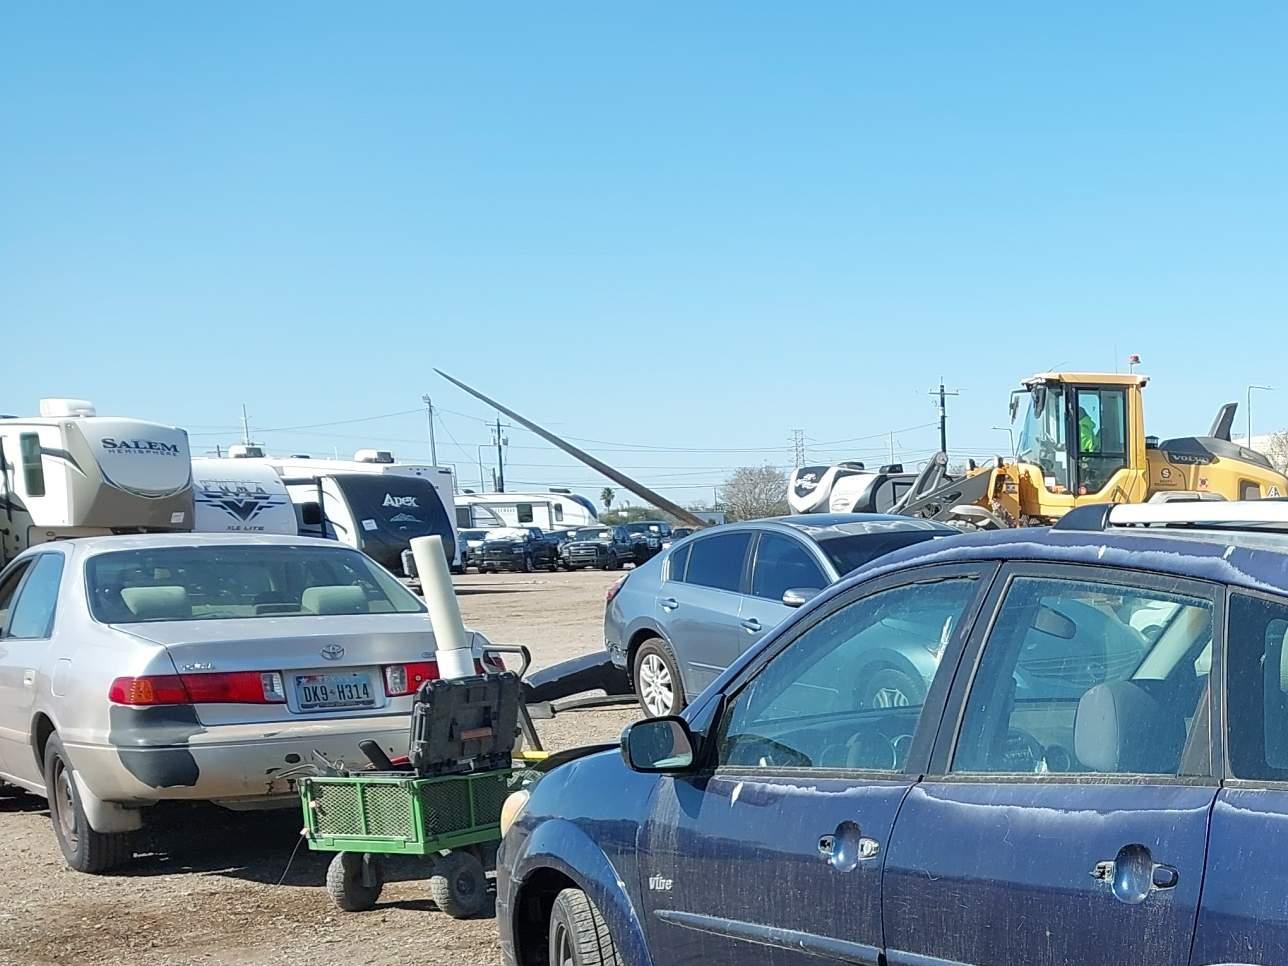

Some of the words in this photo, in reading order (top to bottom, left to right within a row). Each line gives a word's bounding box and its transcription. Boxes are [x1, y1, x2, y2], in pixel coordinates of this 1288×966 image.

[101, 438, 179, 453] SALEM
[1171, 454, 1209, 465] VOLVO
[382, 493, 420, 508] Apex
